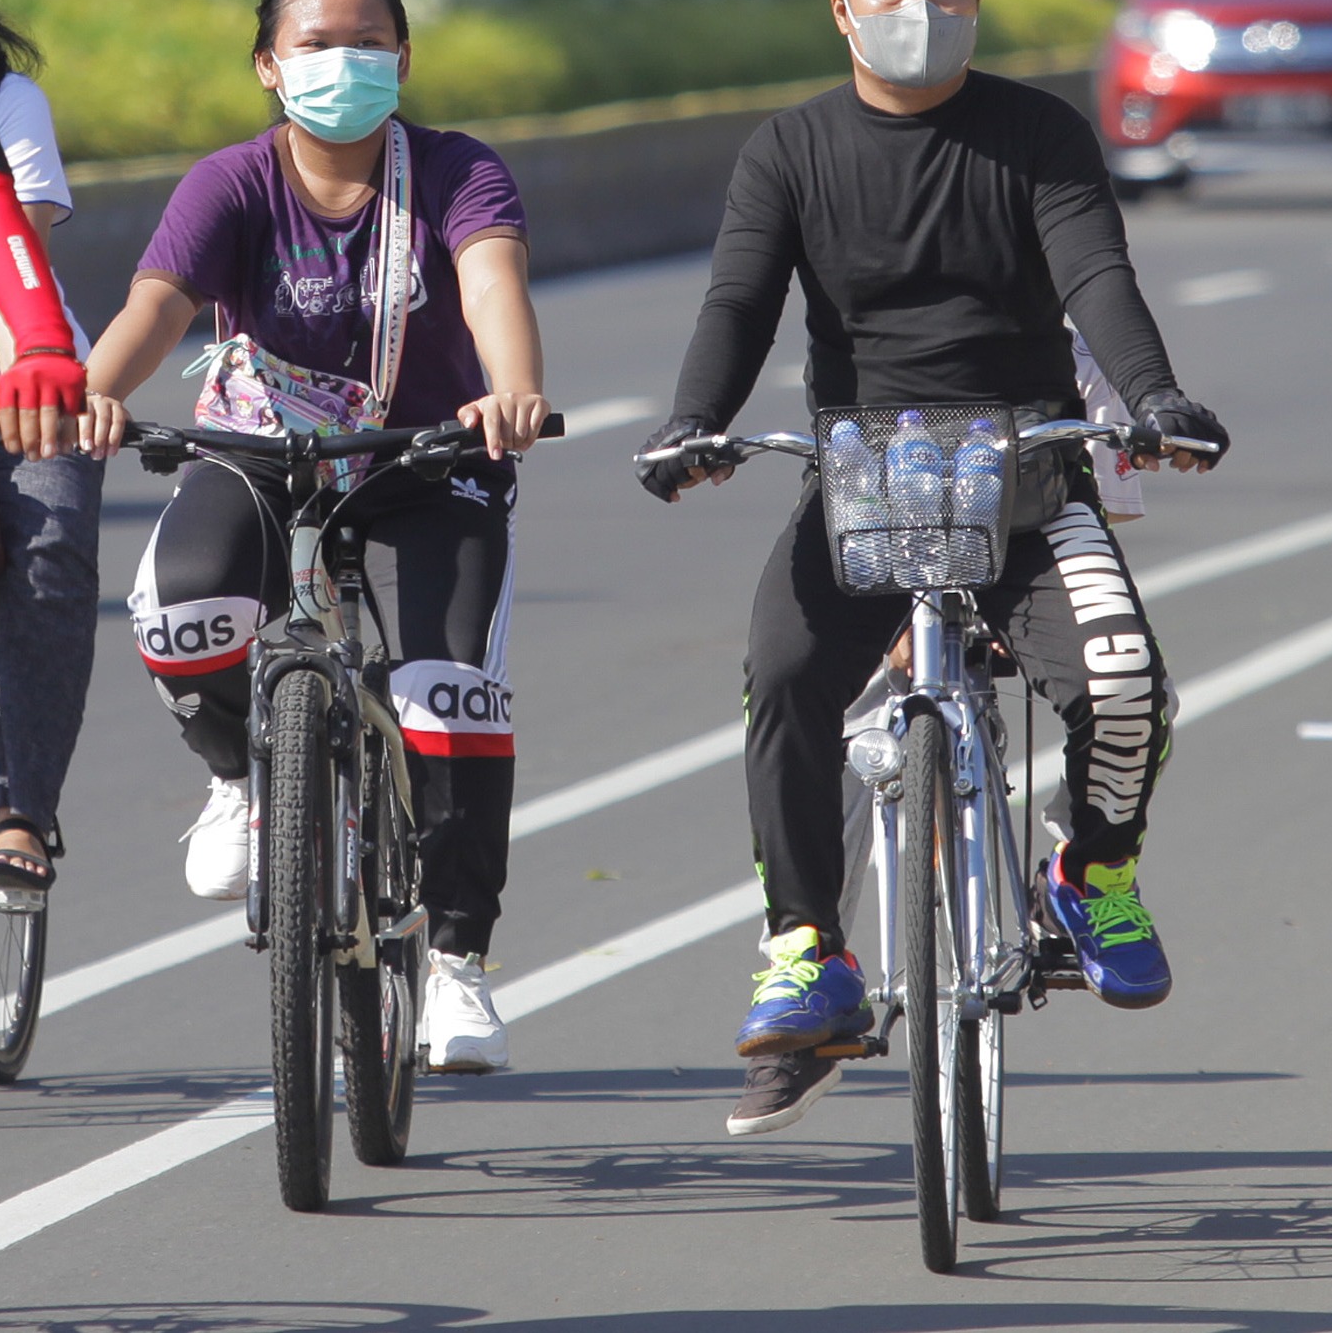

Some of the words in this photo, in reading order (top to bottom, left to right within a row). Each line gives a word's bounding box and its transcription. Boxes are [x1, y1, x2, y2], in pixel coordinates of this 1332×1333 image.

[7, 235, 41, 290] SHIMANO
[249, 827, 259, 881] ZOOM
[347, 827, 357, 881] ZOOM
